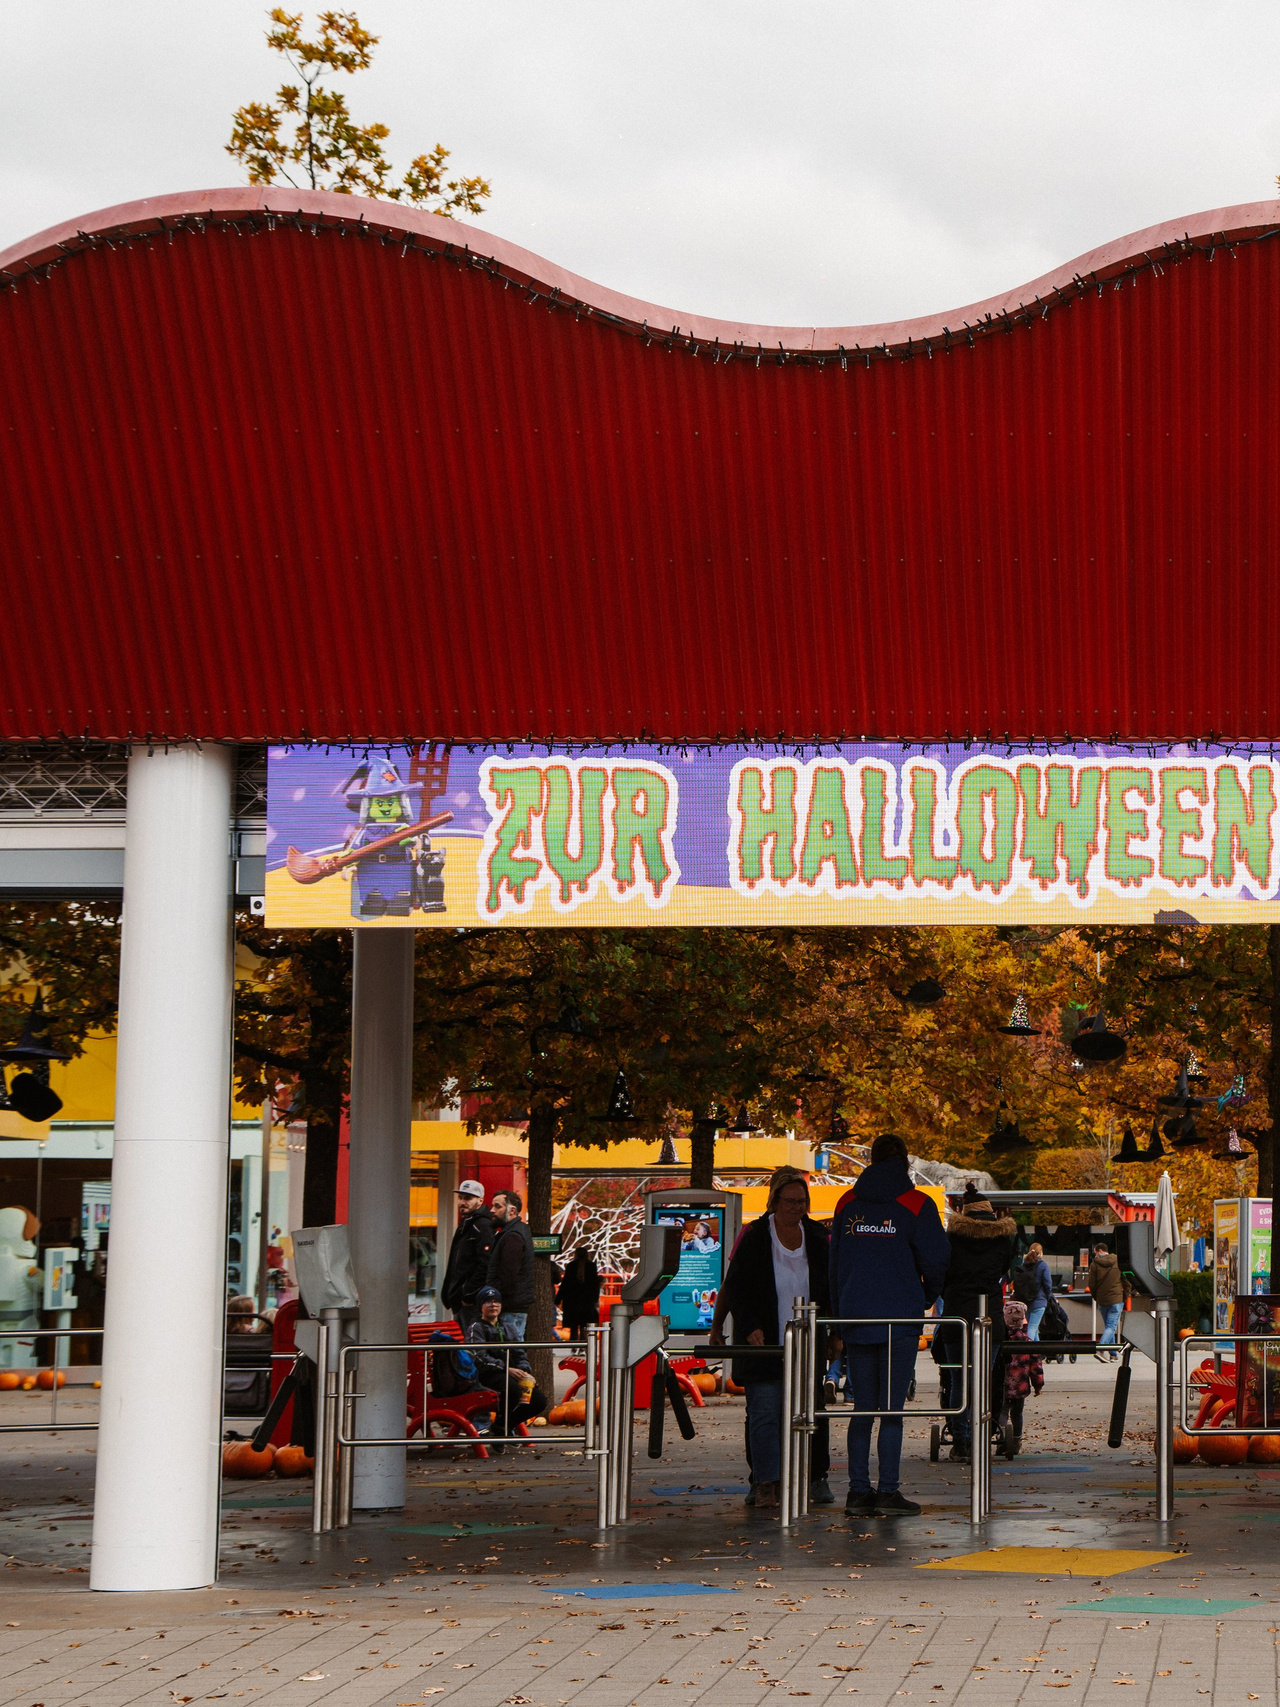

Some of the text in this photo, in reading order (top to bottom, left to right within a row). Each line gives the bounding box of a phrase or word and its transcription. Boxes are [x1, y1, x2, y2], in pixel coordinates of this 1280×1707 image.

[486, 764, 672, 914] ZUR
[736, 763, 1278, 899] HALLOWEEN
[1259, 1207, 1272, 1216] EVEN
[856, 1219, 897, 1234] LEGOLAND
